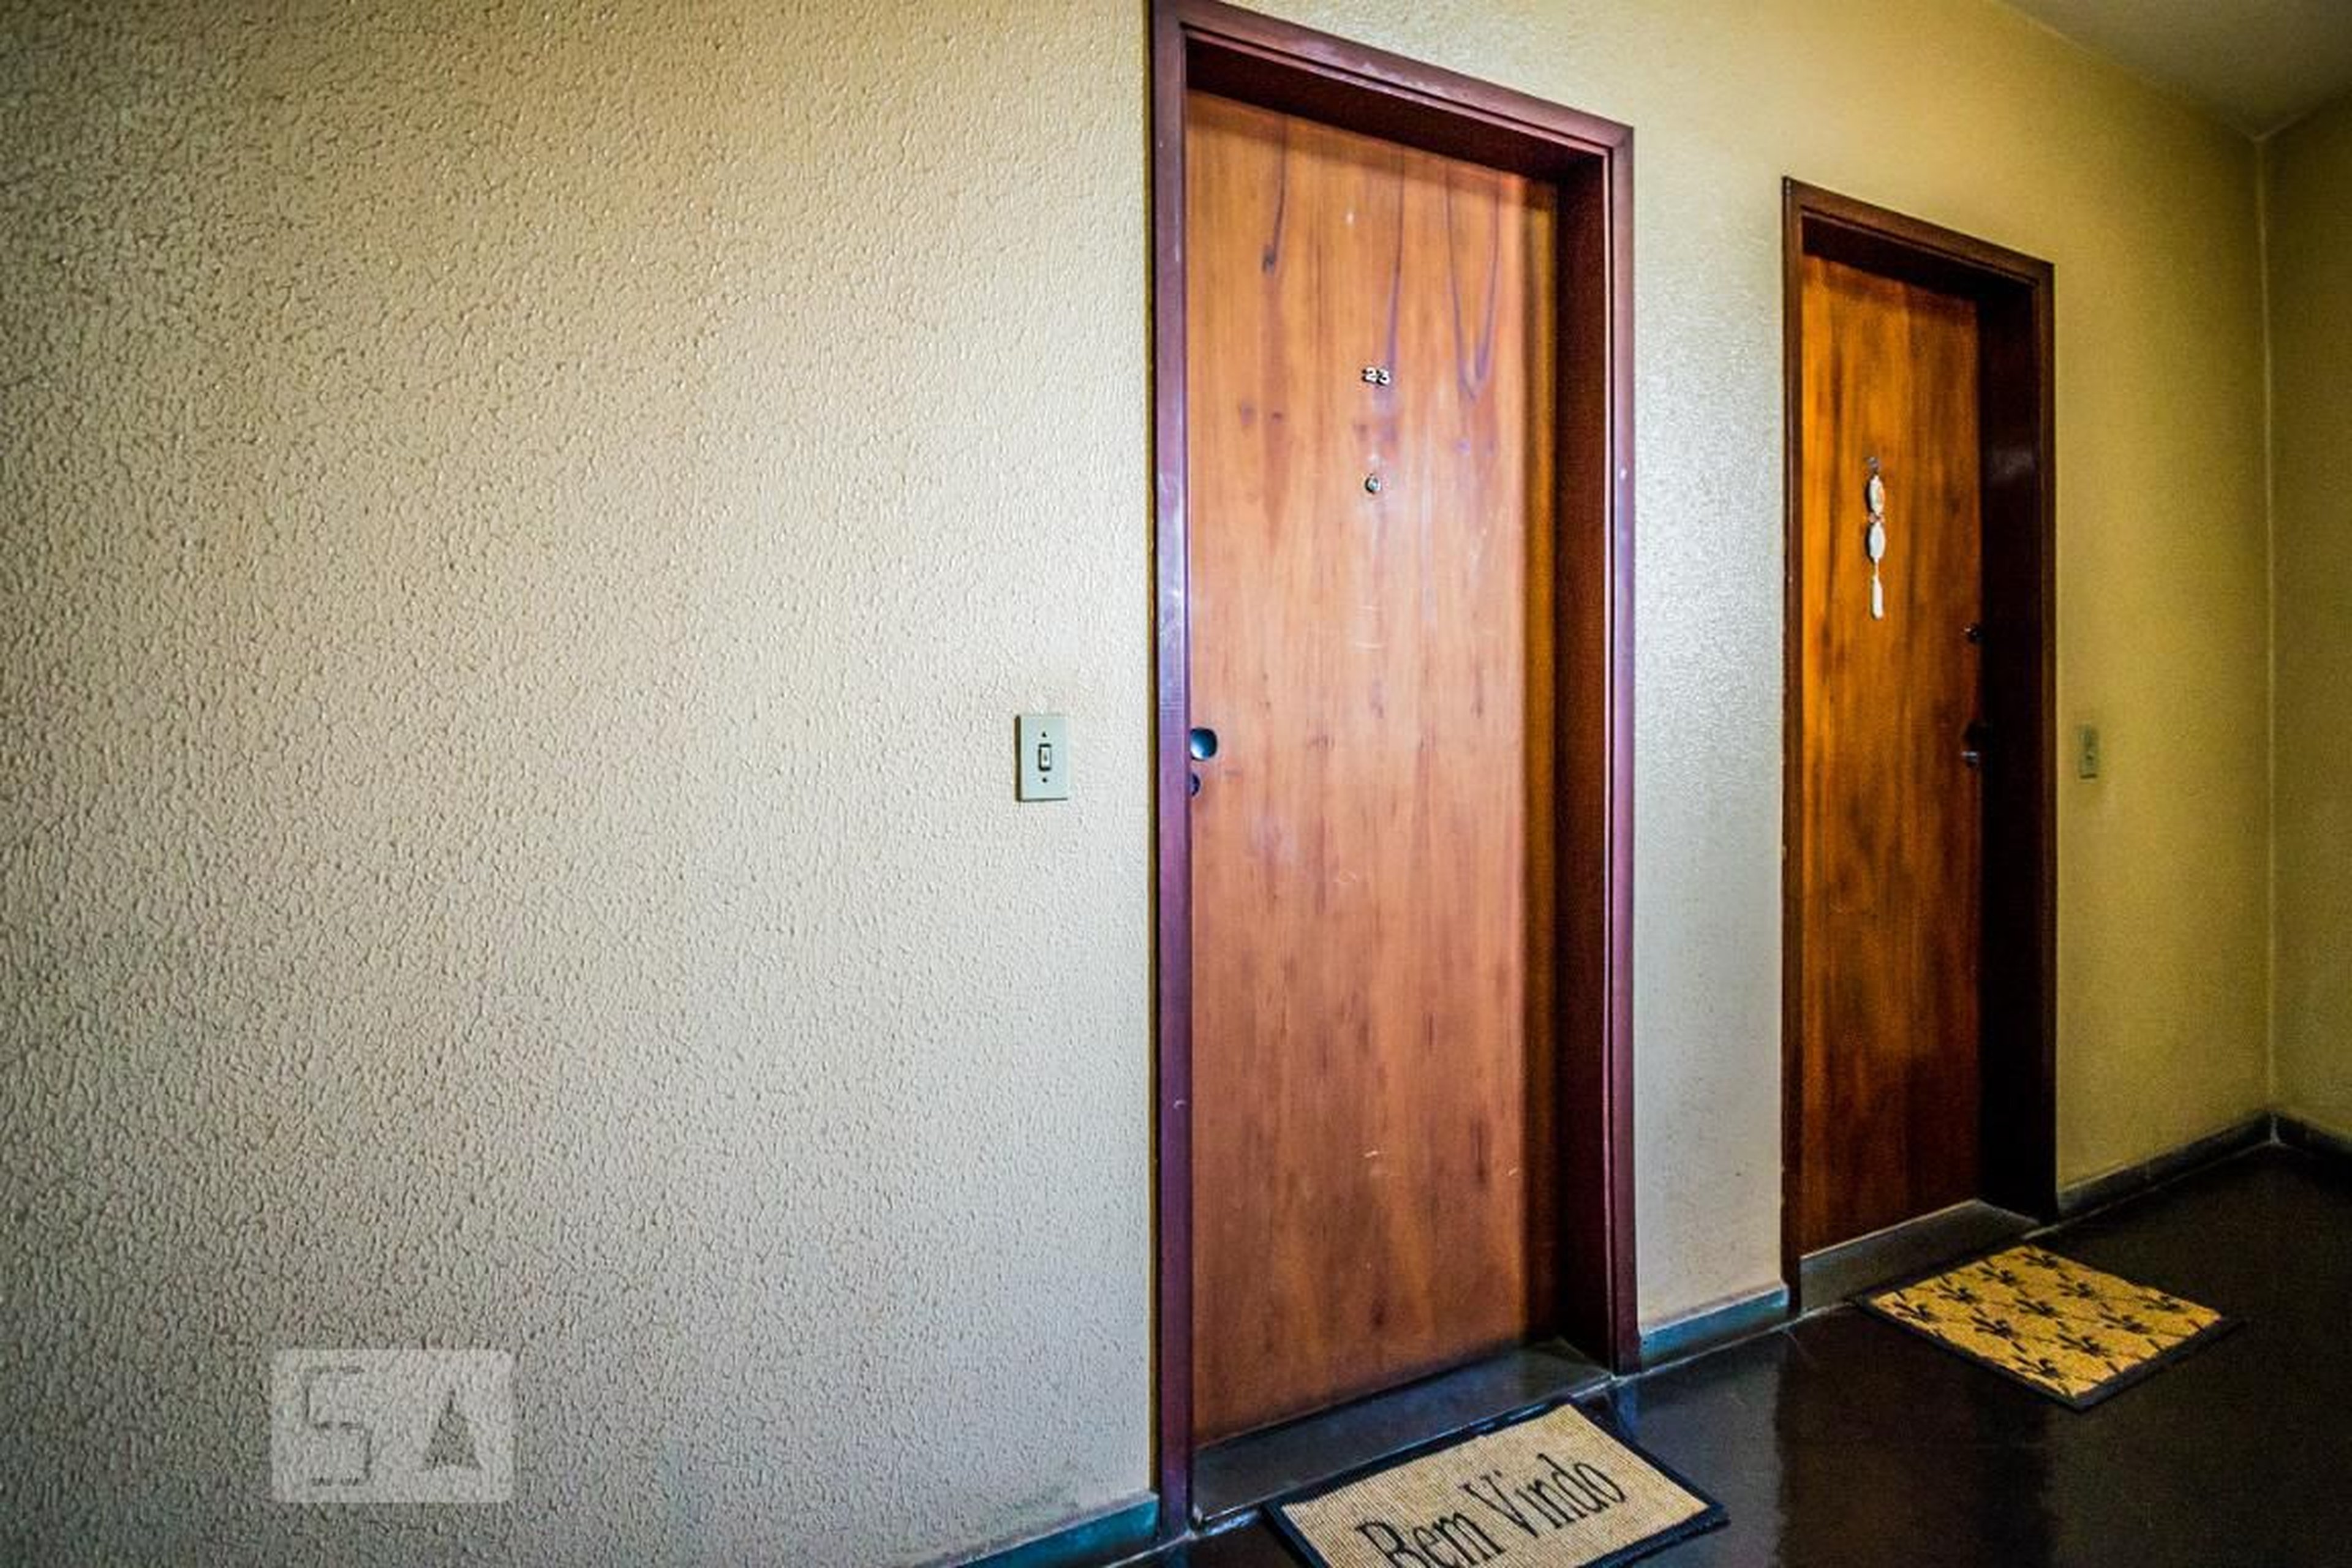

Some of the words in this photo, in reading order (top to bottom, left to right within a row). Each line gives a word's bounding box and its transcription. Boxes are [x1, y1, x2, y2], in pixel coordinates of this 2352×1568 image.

[1362, 366, 1390, 386] 23
[1355, 1511, 1506, 1568] Bem
[1461, 1453, 1627, 1539] Vindo
